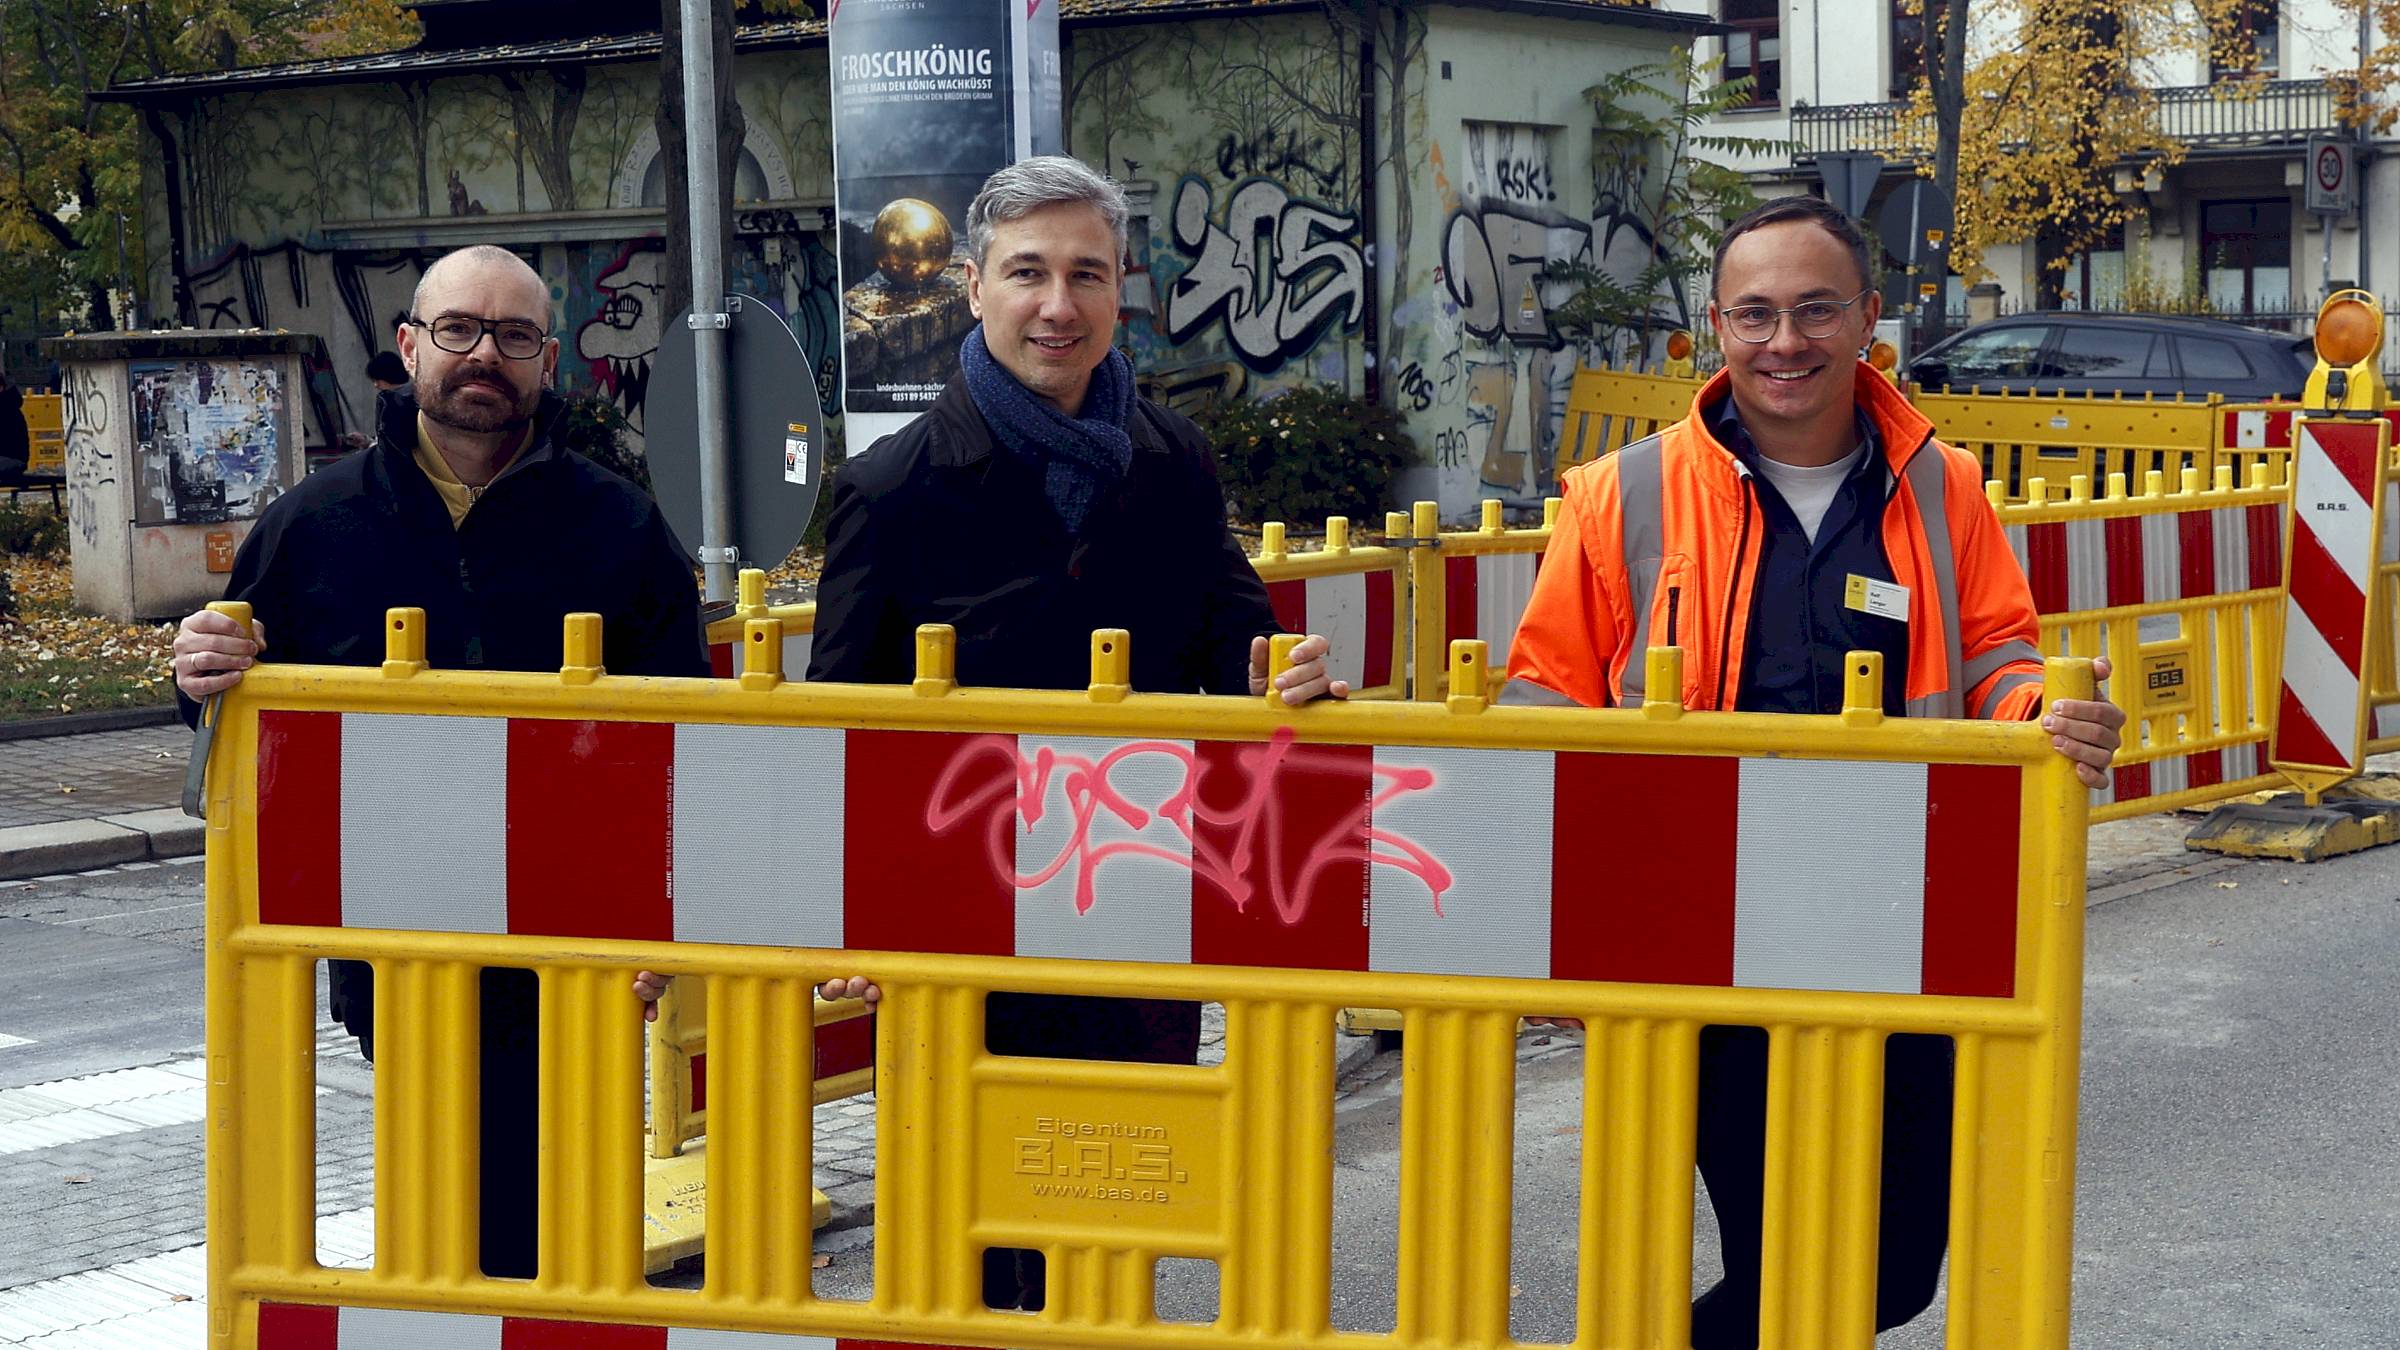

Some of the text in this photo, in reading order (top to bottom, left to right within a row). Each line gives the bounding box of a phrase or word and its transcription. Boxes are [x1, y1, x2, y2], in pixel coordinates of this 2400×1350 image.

[841, 43, 993, 81] FROSCHKÖNIG
[869, 80, 888, 93] MAN
[888, 79, 906, 92] DEN
[906, 77, 936, 91] KÖNIG
[936, 77, 993, 91] WACHKÜSST
[900, 93, 913, 102] FREI
[913, 92, 930, 101] NACH
[930, 92, 943, 101] DEN
[943, 90, 972, 101] BRÜDERN
[972, 91, 993, 100] GRIMM
[2323, 157, 2338, 178] 30
[892, 392, 909, 401] 0351
[908, 392, 919, 401] 89
[1036, 1117, 1166, 1139] Eigentum
[1014, 1137, 1188, 1183] B.A.S.
[1031, 1183, 1168, 1202] www.bas.de
